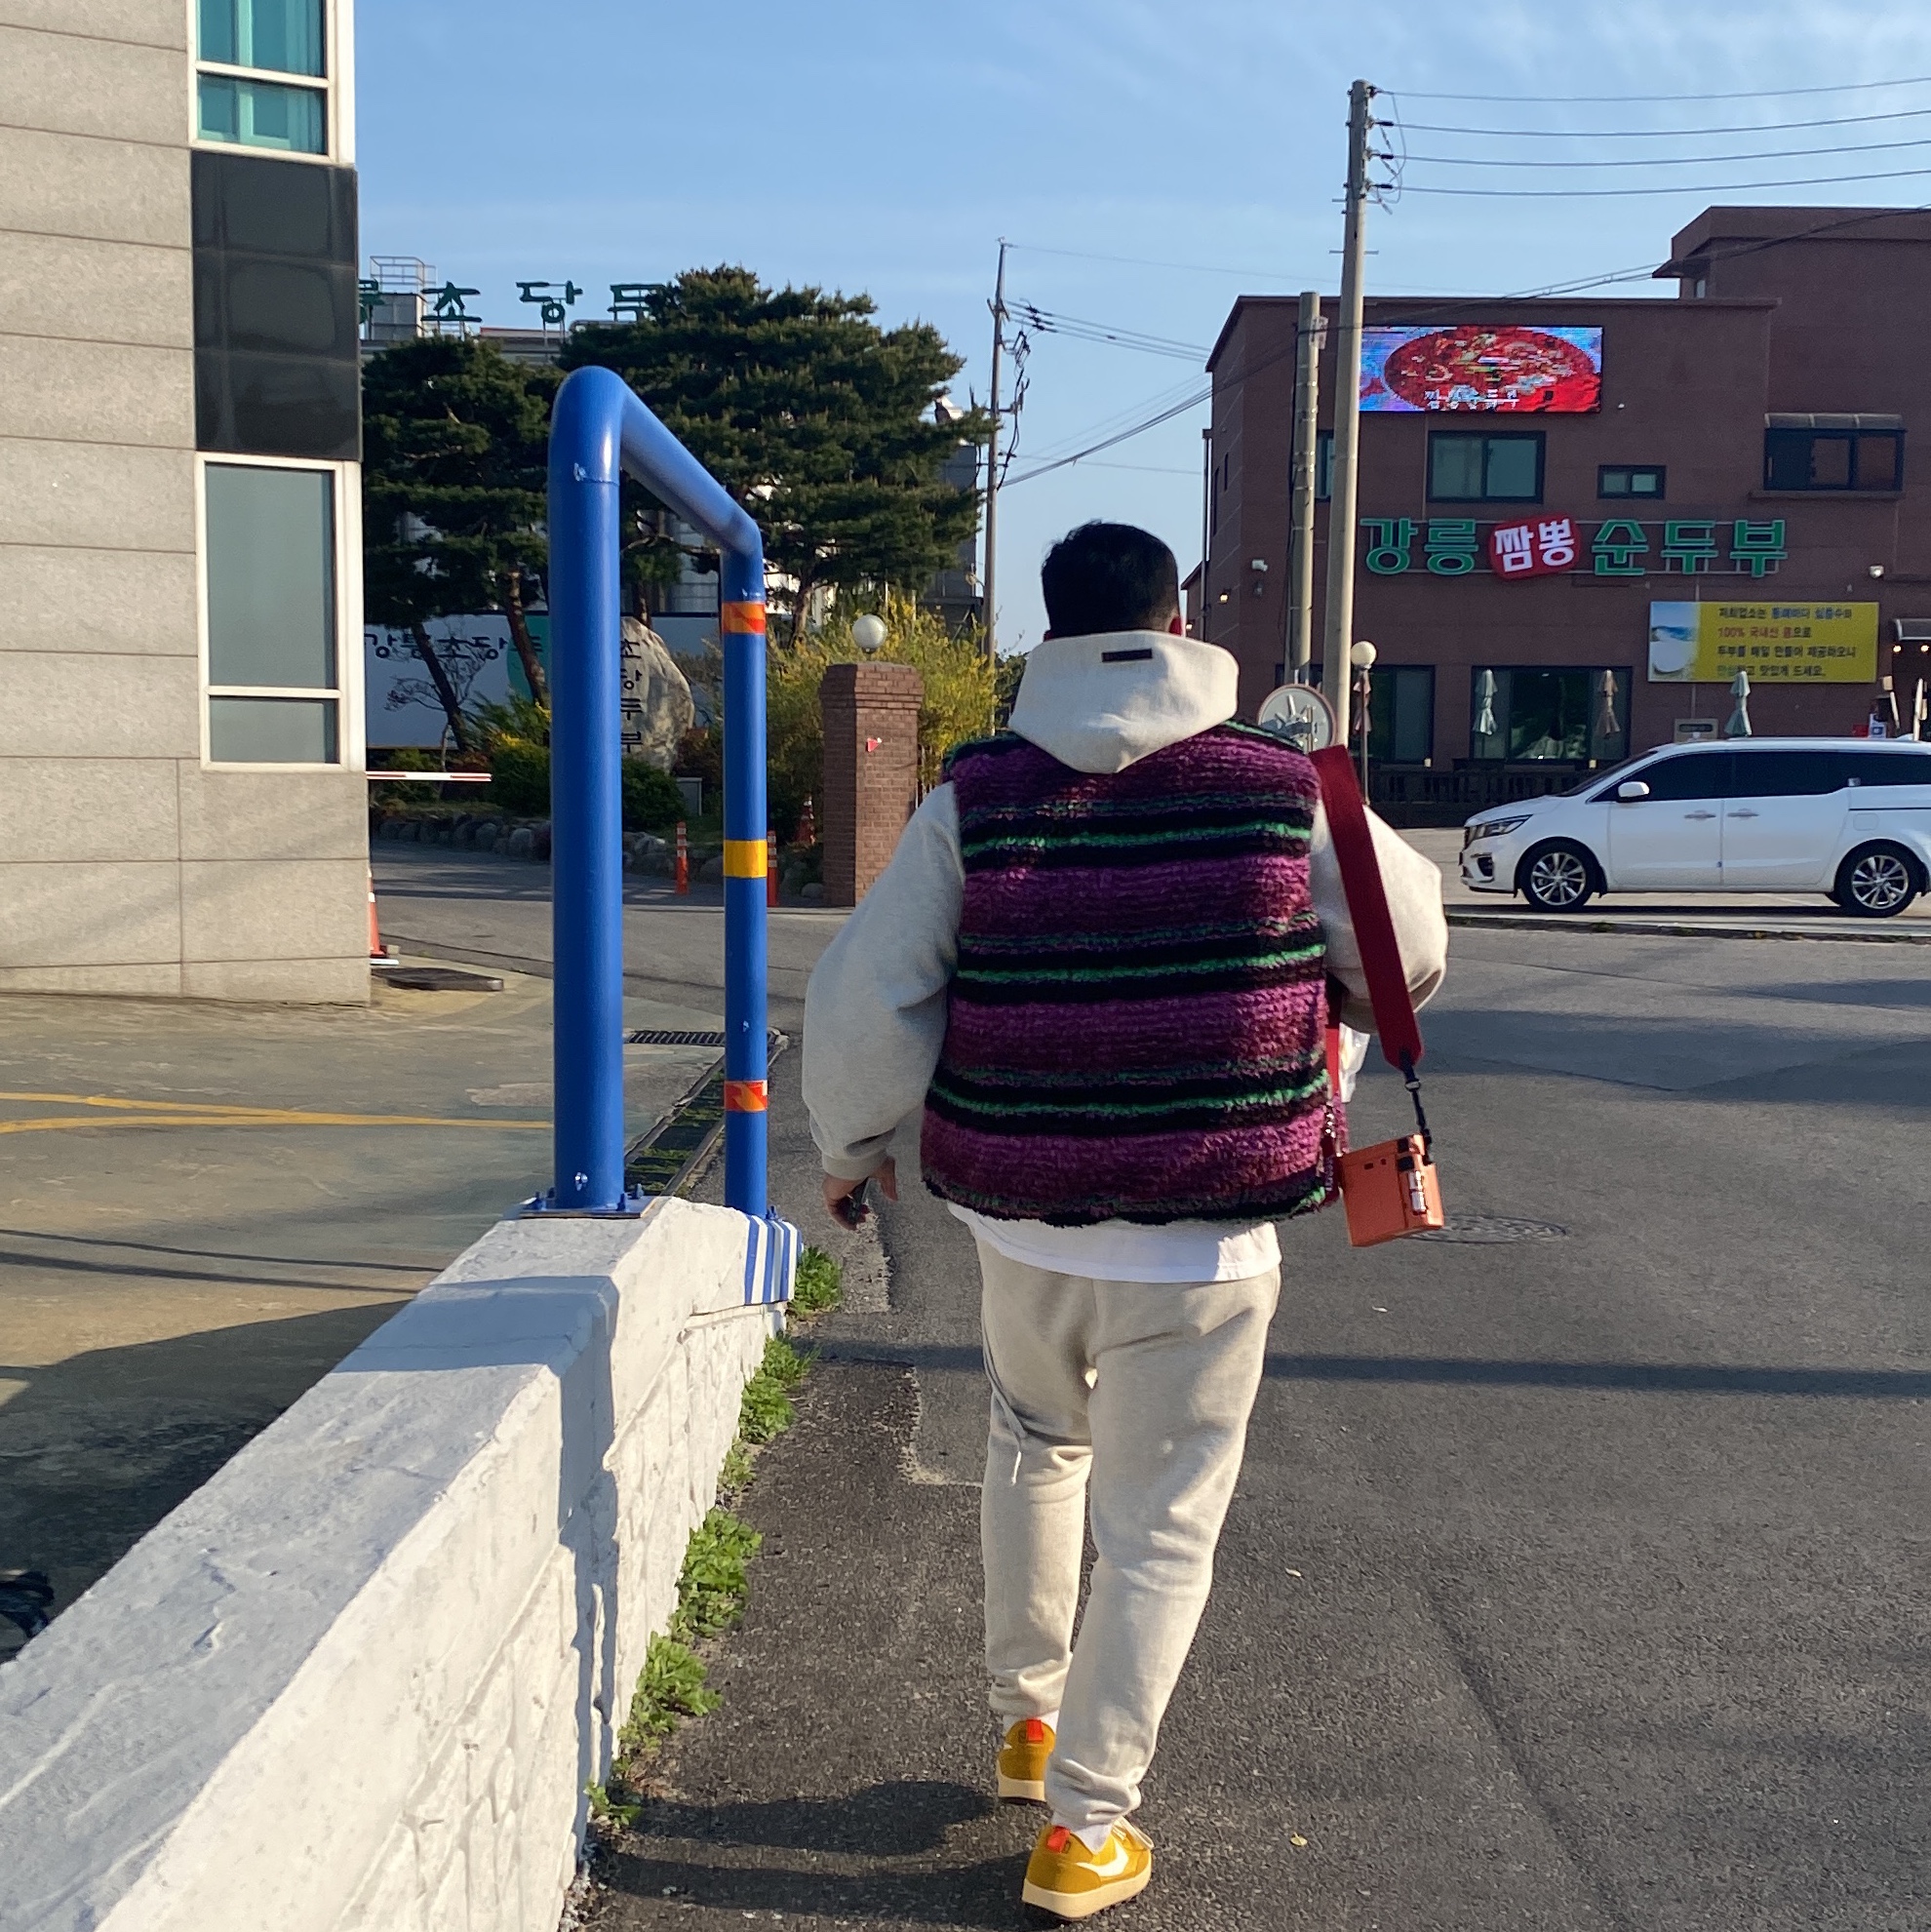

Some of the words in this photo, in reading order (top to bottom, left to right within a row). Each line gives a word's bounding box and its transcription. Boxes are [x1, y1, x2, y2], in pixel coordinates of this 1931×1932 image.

[1360, 517, 1479, 575] 강릉
[1494, 518, 1576, 573] 짬뽕
[1591, 519, 1789, 577] 순두부
[1717, 626, 1746, 639] 100%
[1751, 627, 1779, 639] 국내산
